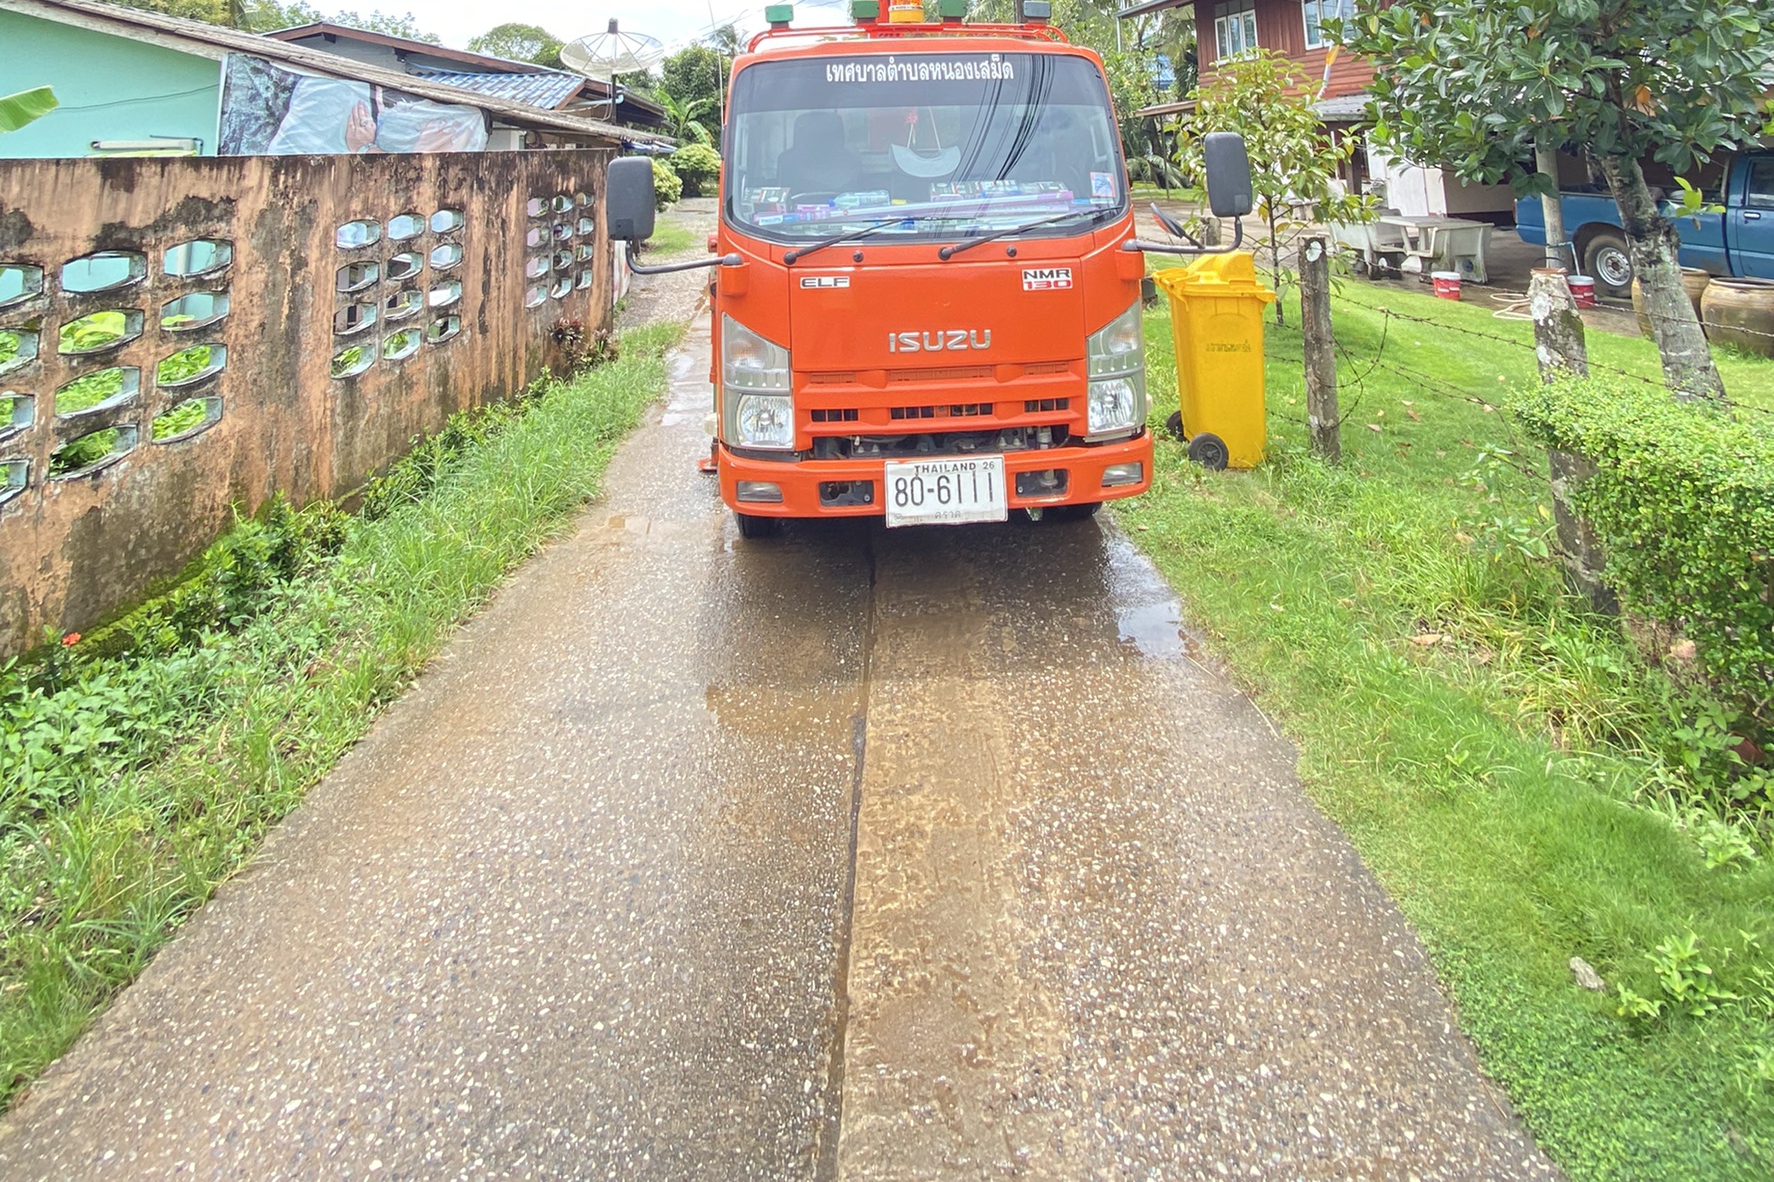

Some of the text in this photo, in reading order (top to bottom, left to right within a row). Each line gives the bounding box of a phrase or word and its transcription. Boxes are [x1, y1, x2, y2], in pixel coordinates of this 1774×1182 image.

[826, 54, 1014, 82] เทศบาลตำบลหนองเสม็ด
[1023, 270, 1070, 279] NMR
[801, 277, 849, 288] ELF
[1024, 280, 1071, 289] 130
[889, 329, 991, 352] ISUZU
[914, 461, 995, 474] THAILAND 26
[895, 472, 993, 507] 80-6111
